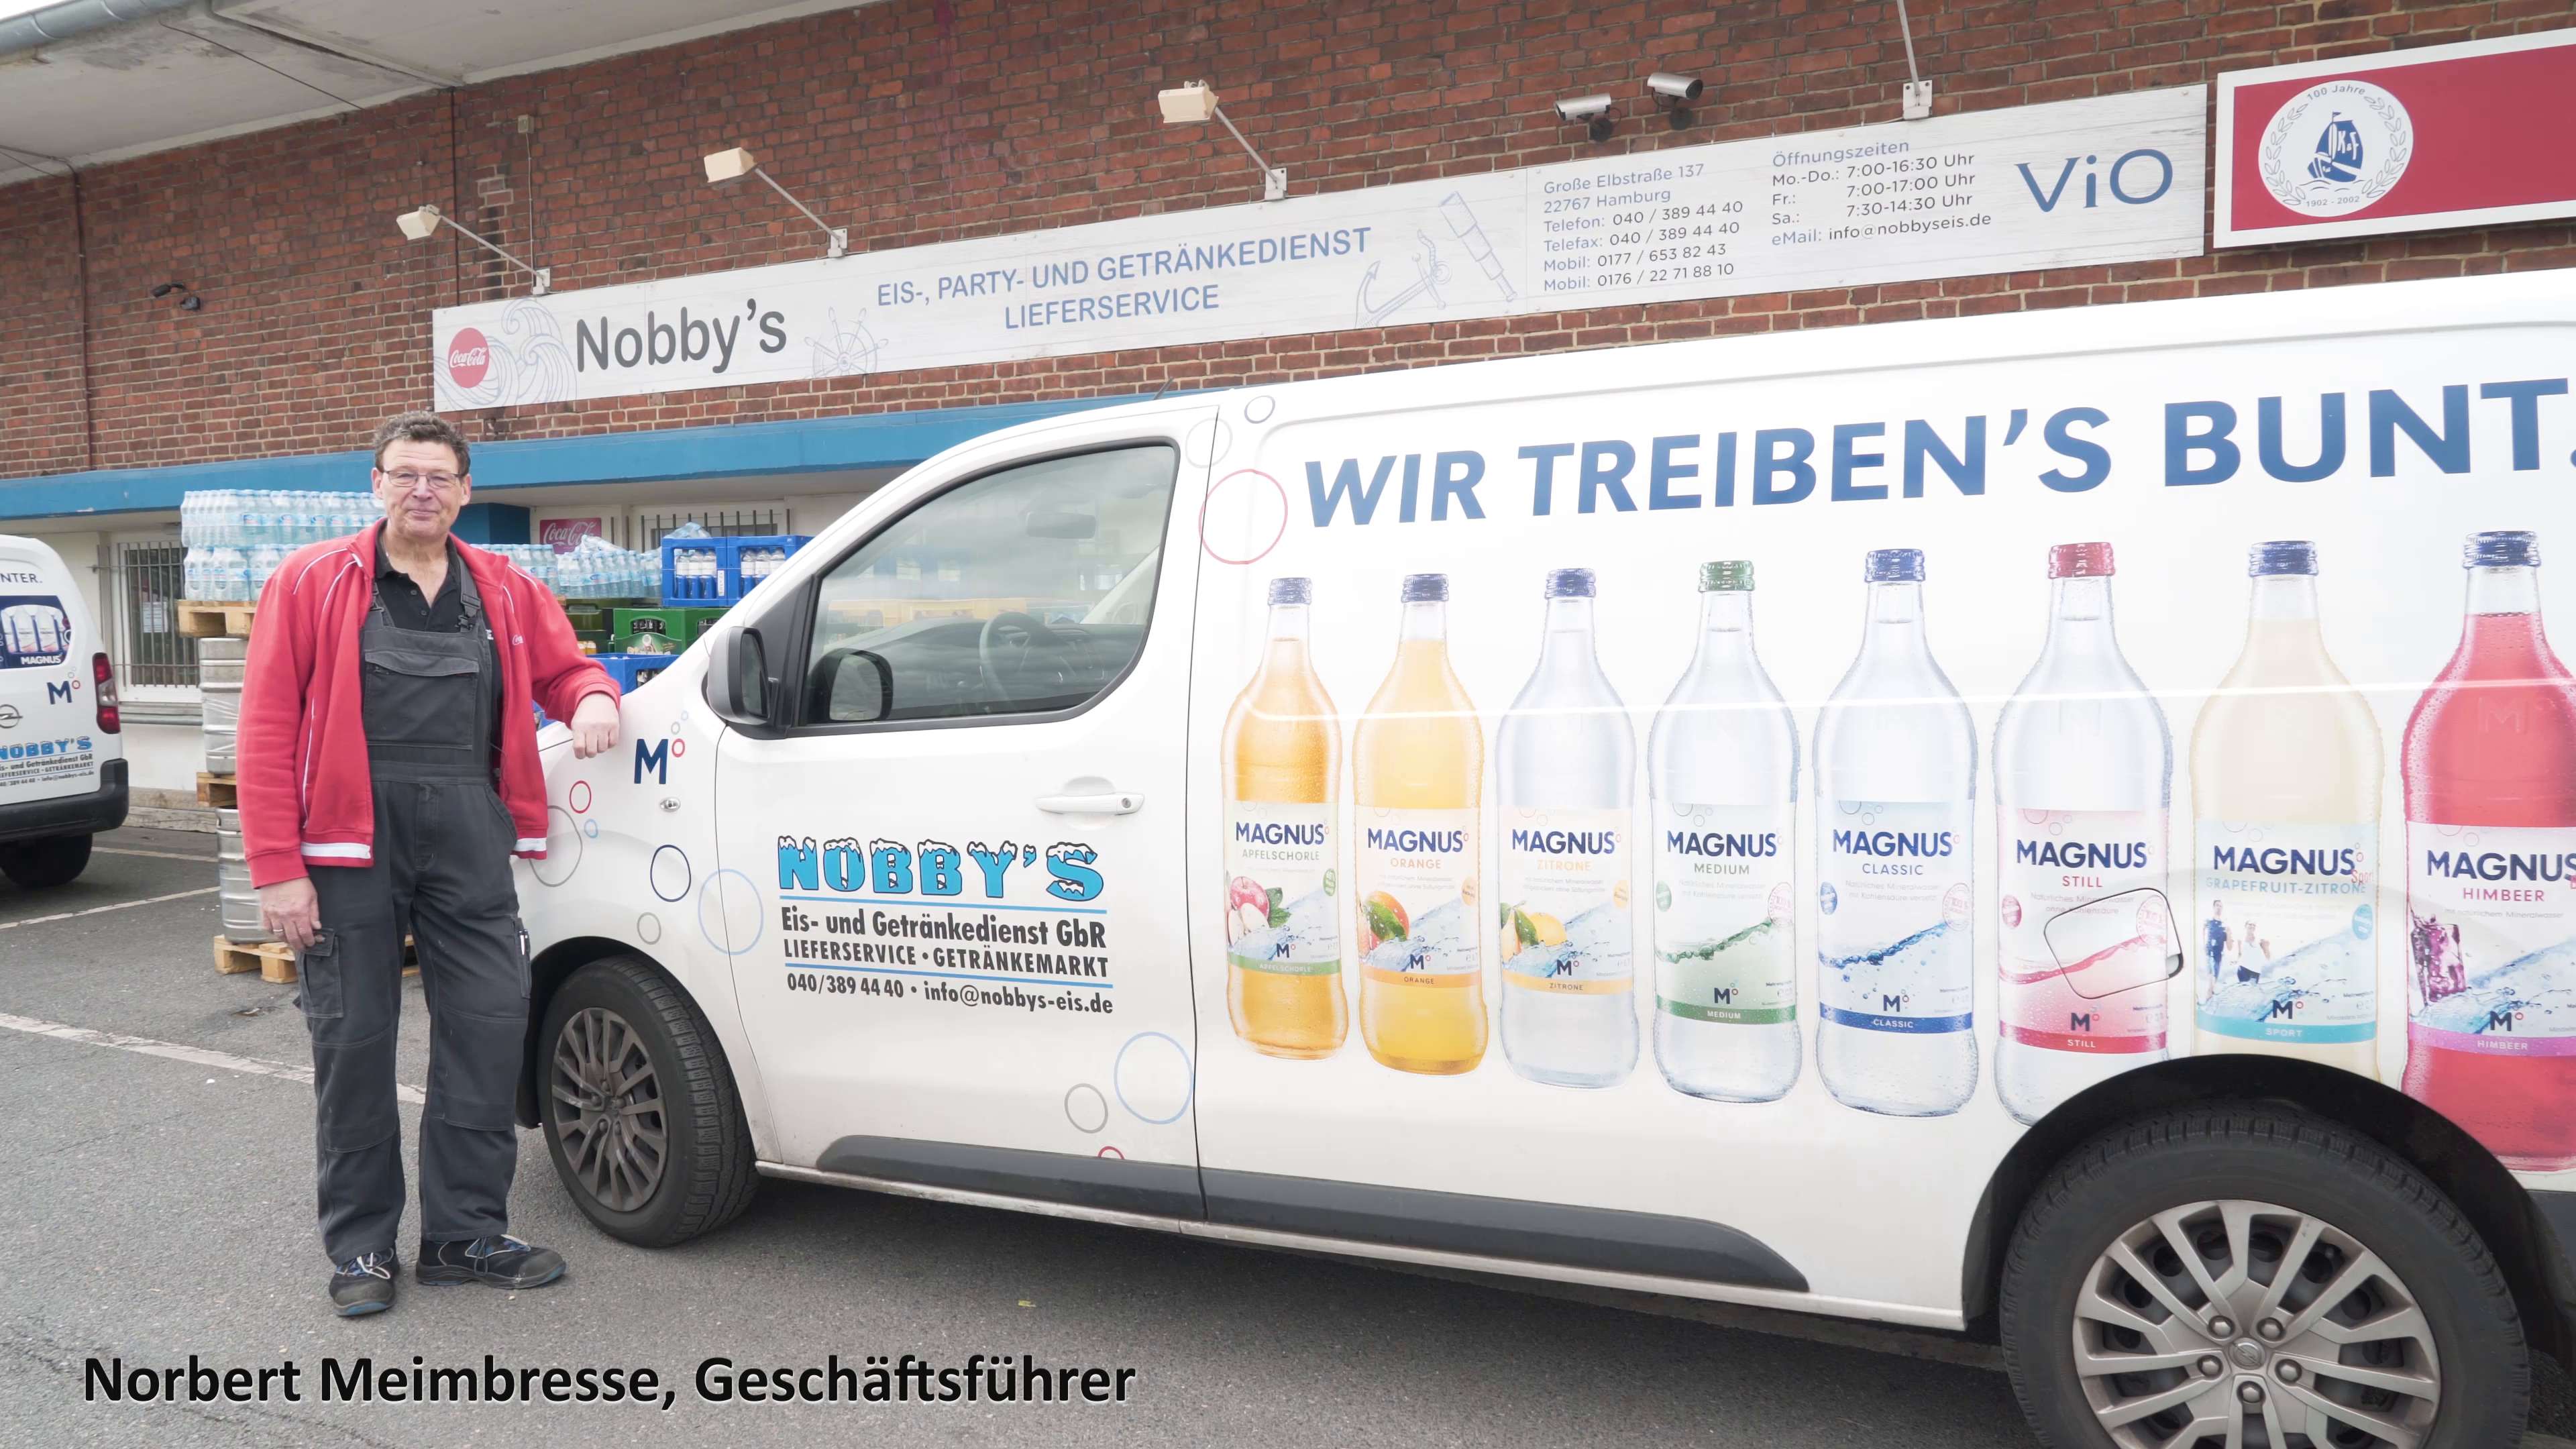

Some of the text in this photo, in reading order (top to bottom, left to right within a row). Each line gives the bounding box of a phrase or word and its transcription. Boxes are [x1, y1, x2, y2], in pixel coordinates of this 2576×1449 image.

[2306, 85, 2366, 101] 100 Jahre
[1773, 142, 1909, 166] Öffnungszeiten
[1544, 164, 1705, 194] Große Elbstraße 137
[1773, 154, 1975, 186] Mo.-Do.: 7:00-16:30 Uhr
[2015, 149, 2174, 213] ViO
[1544, 190, 1671, 213] 22767 Hamburg
[1772, 173, 1975, 205] Fr.: 7:00-17:00 Uhr
[2306, 196, 2360, 207] 1902 2002
[1544, 201, 1743, 233] Telefon: 040 / 389 44 40
[1772, 194, 1972, 225] Sa.: 7:30-14:30 Uhr
[1544, 222, 1739, 252] Telefax: 040 / 389 44 40
[1772, 213, 1992, 246] eMail: info@nobbyseis.de
[877, 227, 1372, 307] EIS-, PARTY- UND GETRÄNKEDIENST
[1544, 244, 1726, 272] Mobil: 0177 / 653 82 43
[1544, 263, 1734, 291] Mobil: 0176 / 22 71 88 10
[1004, 284, 1220, 330] LIEFERSERVICE
[576, 298, 788, 374] Nobby's
[1304, 449, 1487, 529] WIR
[1516, 407, 2112, 517] TREIBEN'S
[21, 655, 62, 665] MAGNUS
[1236, 821, 1325, 846] MAGNUS
[1367, 828, 1463, 853] MAGNUS
[1512, 829, 1615, 855] MAGNUS
[1667, 830, 1776, 857] MAGNUS
[1833, 829, 1952, 858] MAGNUS
[1242, 849, 1320, 861] APFELSCHORLE
[1390, 858, 1442, 869] ORANGE
[1537, 859, 1592, 871] ZITRONE
[2017, 839, 2147, 869] MAGNUS
[2214, 845, 2355, 875] MAGNUS
[2427, 849, 2576, 882] MAGNUS
[777, 836, 1104, 902] NOBBY'S
[1695, 863, 1750, 875] MEDIUM
[1862, 863, 1924, 875] CLASSIC
[2062, 875, 2103, 888] STILL
[2031, 893, 2074, 903] Natürliches
[2206, 877, 2367, 895] GRAPEFRUIT-ZITRONE
[2463, 888, 2545, 902] HIMBEER
[2506, 910, 2564, 919] Mineralwasser
[782, 906, 1106, 949] Eis- und Getränkedienst GbR
[784, 939, 1108, 977] LIEFERSERVICE GETRÄNKEMARKT
[1259, 963, 1311, 972] APFELSCHORLE
[1403, 976, 1435, 984] ORANGE
[1550, 983, 1583, 991] ZITRONE
[788, 973, 1114, 1014] 040/389 44 40 info@nobbys-eis.de
[1707, 1010, 1741, 1020] MEDIUM
[1873, 1018, 1914, 1029] CLASSIC
[2067, 1039, 2096, 1048] STILL
[2265, 1028, 2303, 1037] SPORT
[2477, 1040, 2528, 1051] HIMBEER
